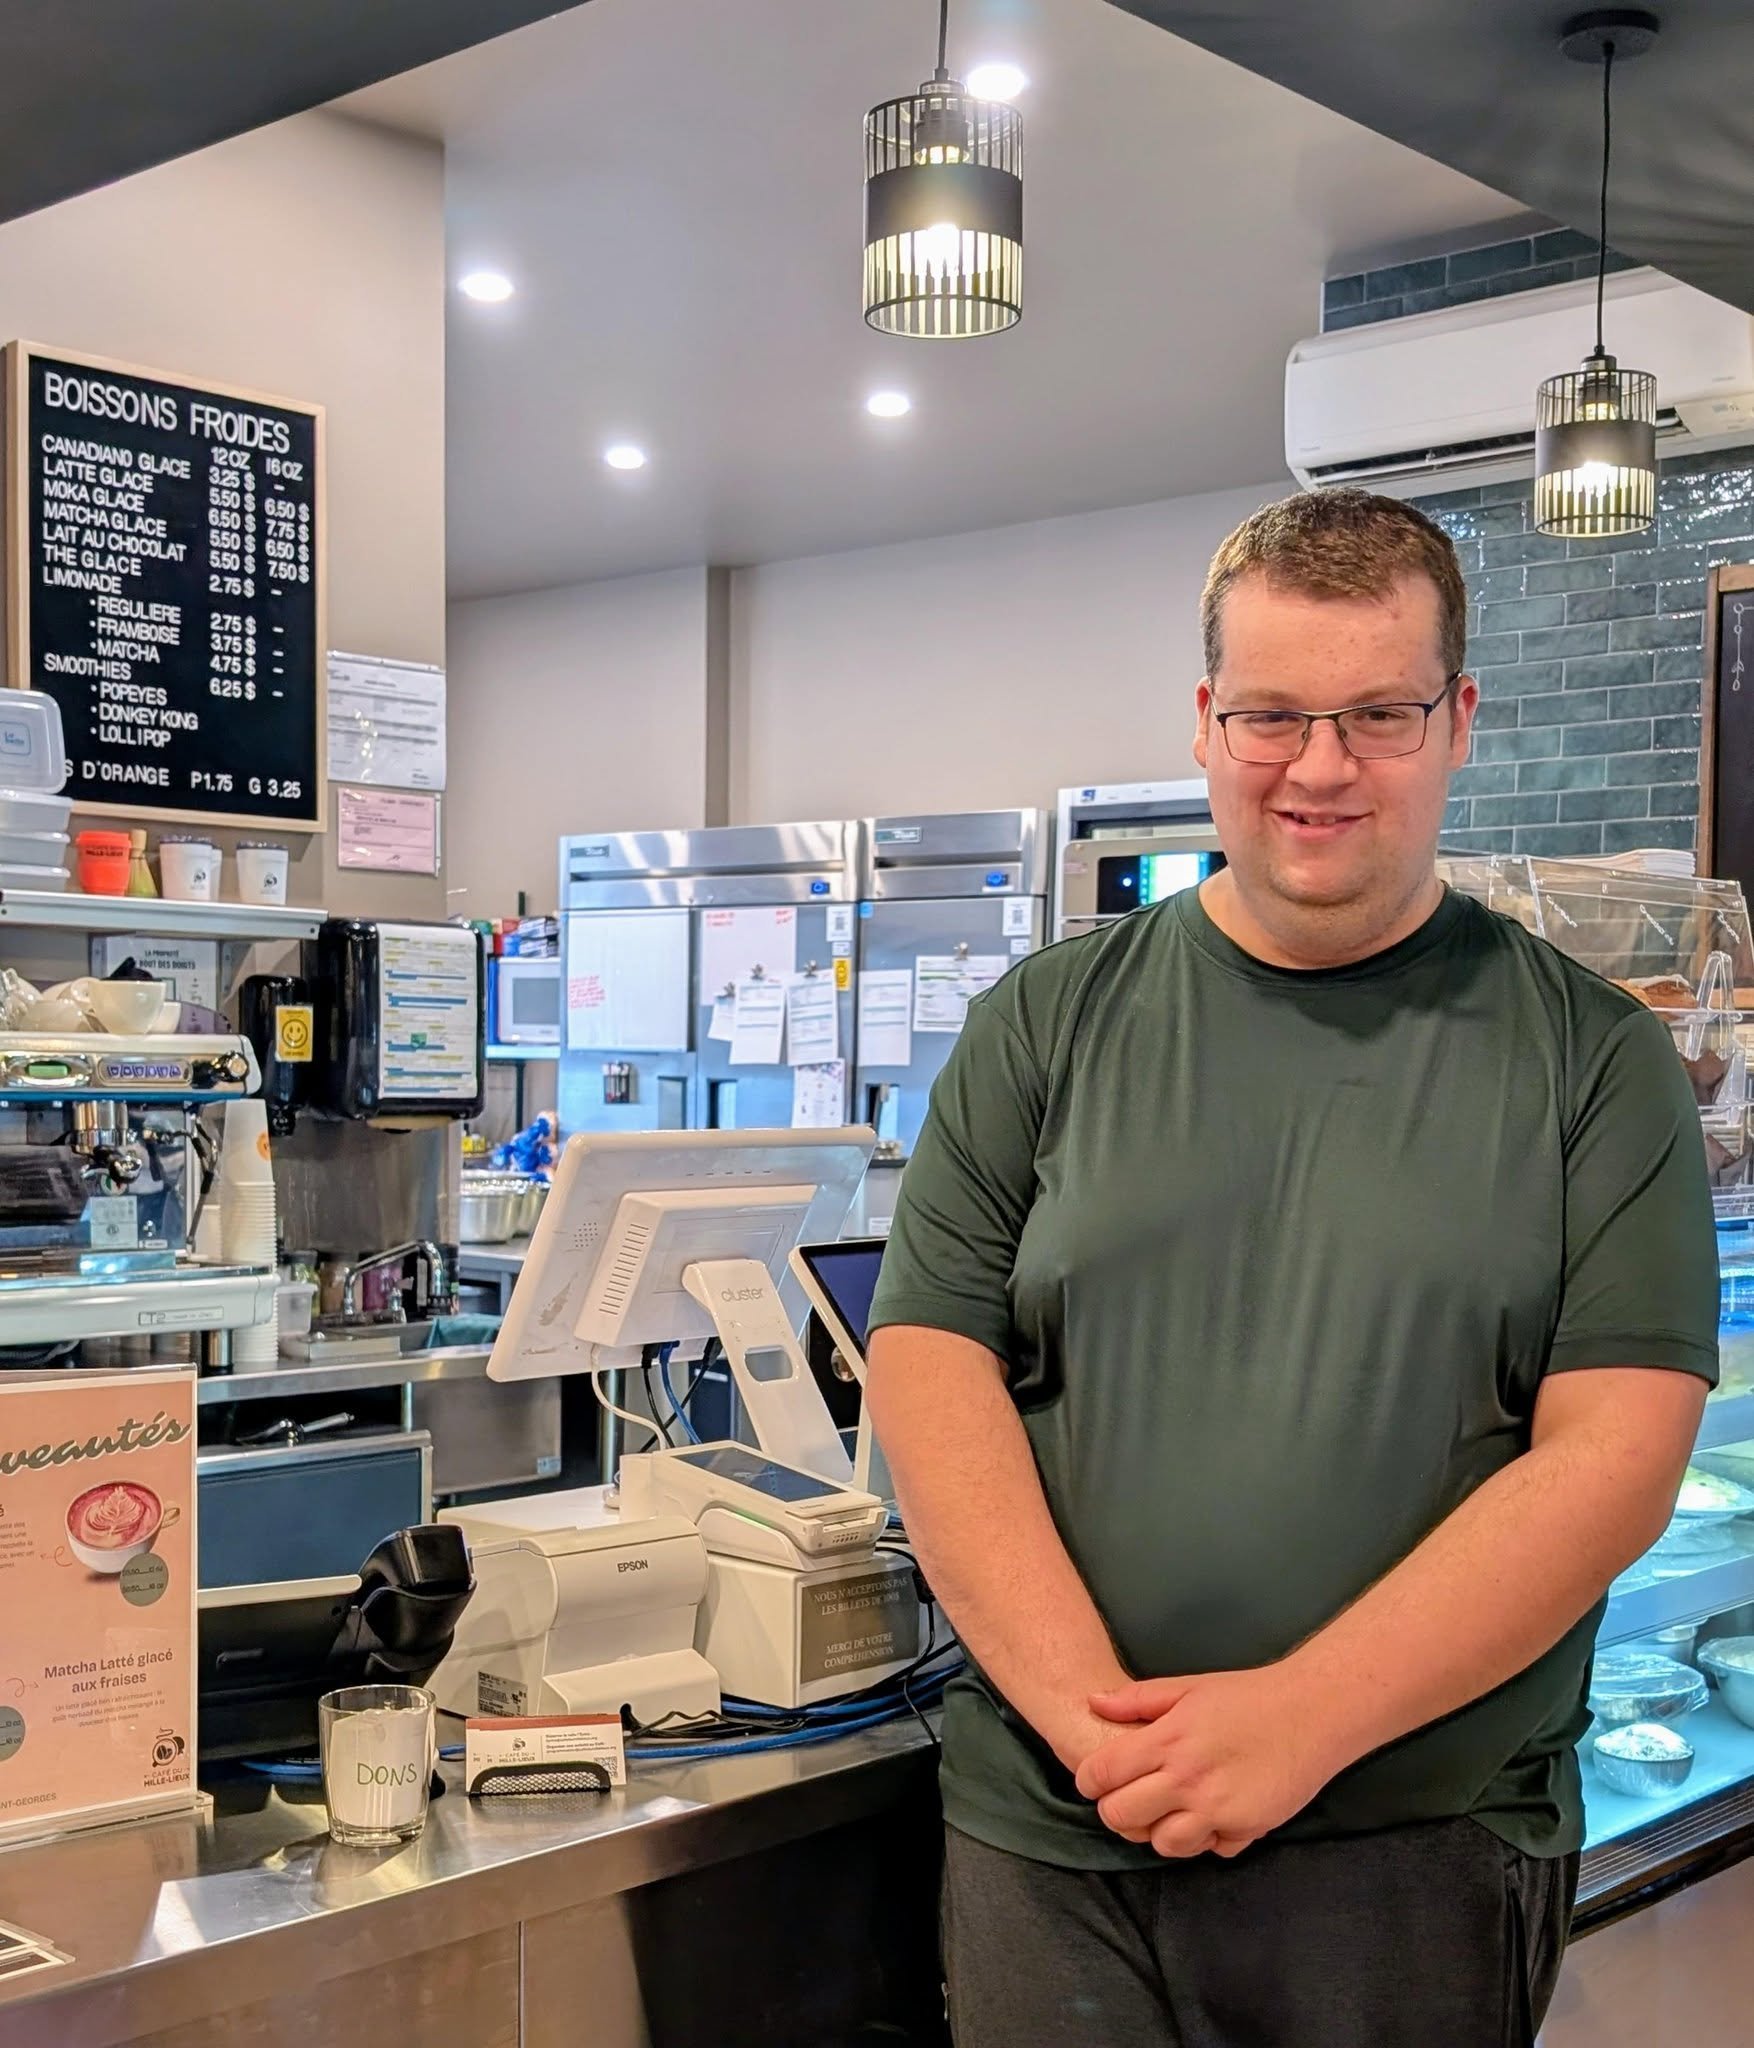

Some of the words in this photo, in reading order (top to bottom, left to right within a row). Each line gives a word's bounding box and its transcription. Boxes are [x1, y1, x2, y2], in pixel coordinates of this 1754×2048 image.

[45, 371, 177, 430] BOISSONS
[190, 402, 290, 453] FROIDES
[42, 435, 132, 468] CANADIANO
[138, 453, 191, 479] GLACE
[43, 457, 96, 483] LATTE
[101, 468, 154, 493] GLACE
[43, 478, 90, 503] MOKA
[93, 487, 144, 513] GLACE
[44, 501, 109, 528] MATCHA
[111, 513, 167, 538] GLACE
[43, 523, 79, 544] LAIT
[82, 529, 104, 548] AU
[108, 533, 187, 561] CHOCOLAT
[43, 543, 77, 566] THE
[81, 551, 142, 576] GLACE
[43, 567, 122, 594] LIMONADE
[44, 653, 131, 680] SMOOTHIES
[160, 710, 198, 730] KONG
[82, 761, 170, 786] D'ORANGE
[249, 777, 261, 794] G
[268, 778, 301, 799] 3.25
[158, 960, 170, 968] DES
[721, 1286, 763, 1302] cluster
[0, 1411, 190, 1476] veautés
[617, 1560, 648, 1573] EPSON
[815, 1592, 836, 1602] NOUS
[894, 1577, 908, 1588] PAS
[822, 1604, 836, 1615] LES
[838, 1598, 870, 1612] BILLETS
[826, 1641, 851, 1654] MERCI
[854, 1638, 865, 1648] DE
[866, 1632, 893, 1644] VOTRE
[45, 1662, 97, 1679] Matcha
[100, 1655, 134, 1670] Latté
[138, 1648, 173, 1667] glacé
[72, 1681, 97, 1693] aux
[100, 1672, 146, 1689] fraises
[144, 1773, 190, 1787] MILLE-LIEUX
[152, 1768, 170, 1777] CAFÉ
[357, 1762, 417, 1786] DONS
[0, 1793, 56, 1808] NT-GEORGES
